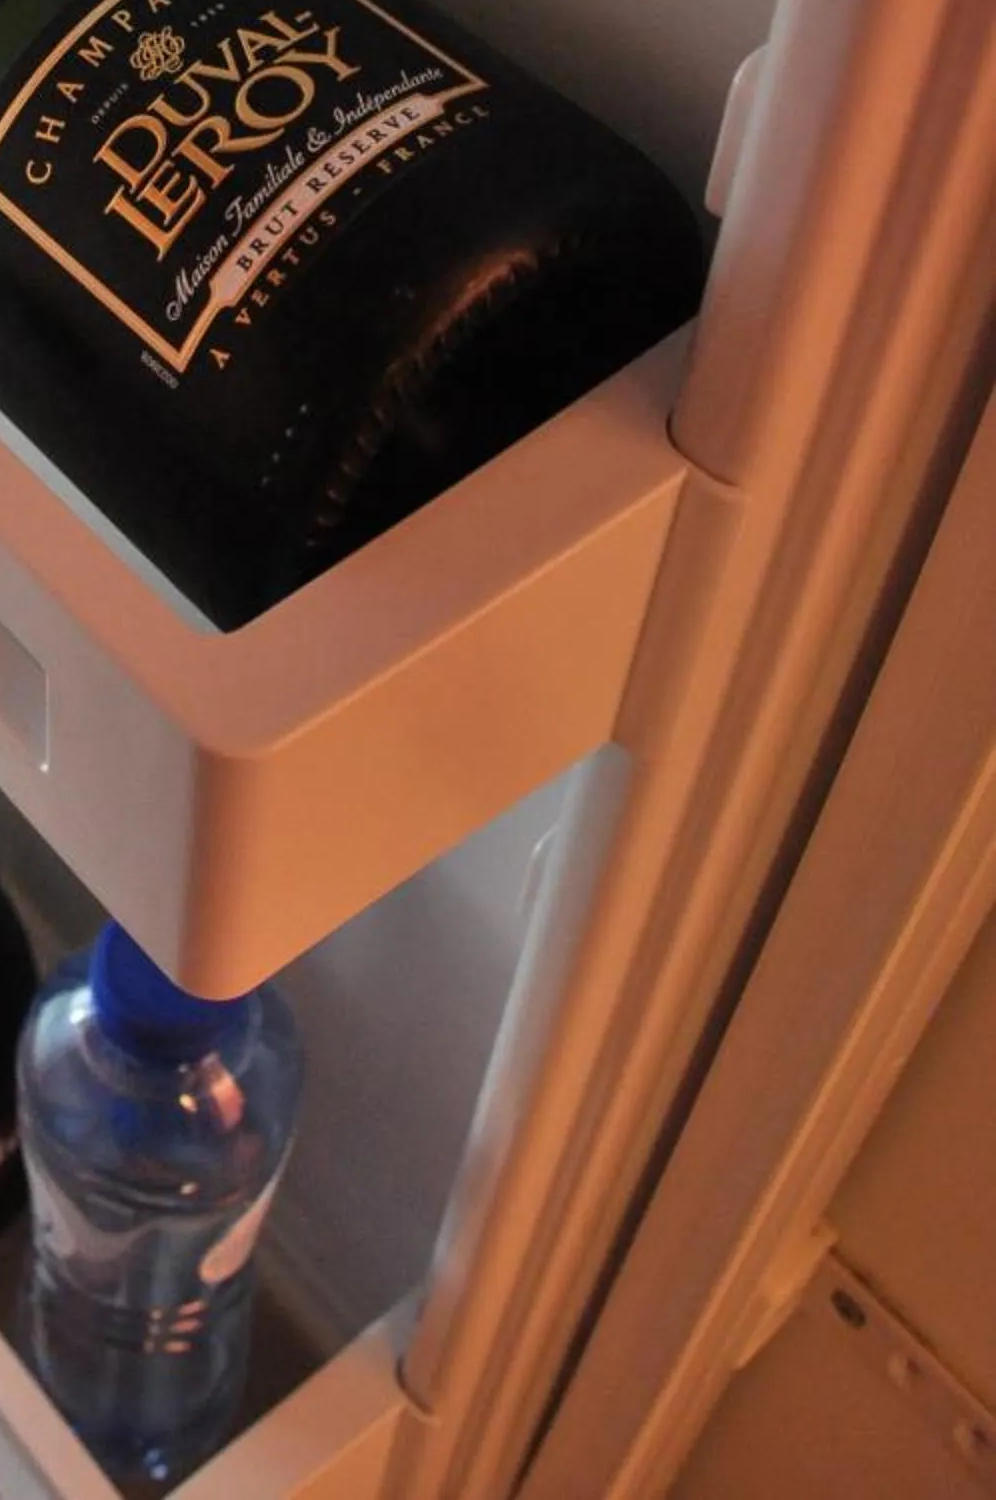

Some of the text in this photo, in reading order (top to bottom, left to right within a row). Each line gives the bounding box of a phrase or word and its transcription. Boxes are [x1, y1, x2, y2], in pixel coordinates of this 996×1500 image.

[104, 26, 362, 263] LEROY
[165, 232, 230, 323] Maison
[224, 143, 305, 239] Familiale
[306, 126, 333, 153] &
[234, 209, 337, 327] VERTUS
[375, 103, 492, 175] FRANCE
[236, 201, 300, 273] BRUT
